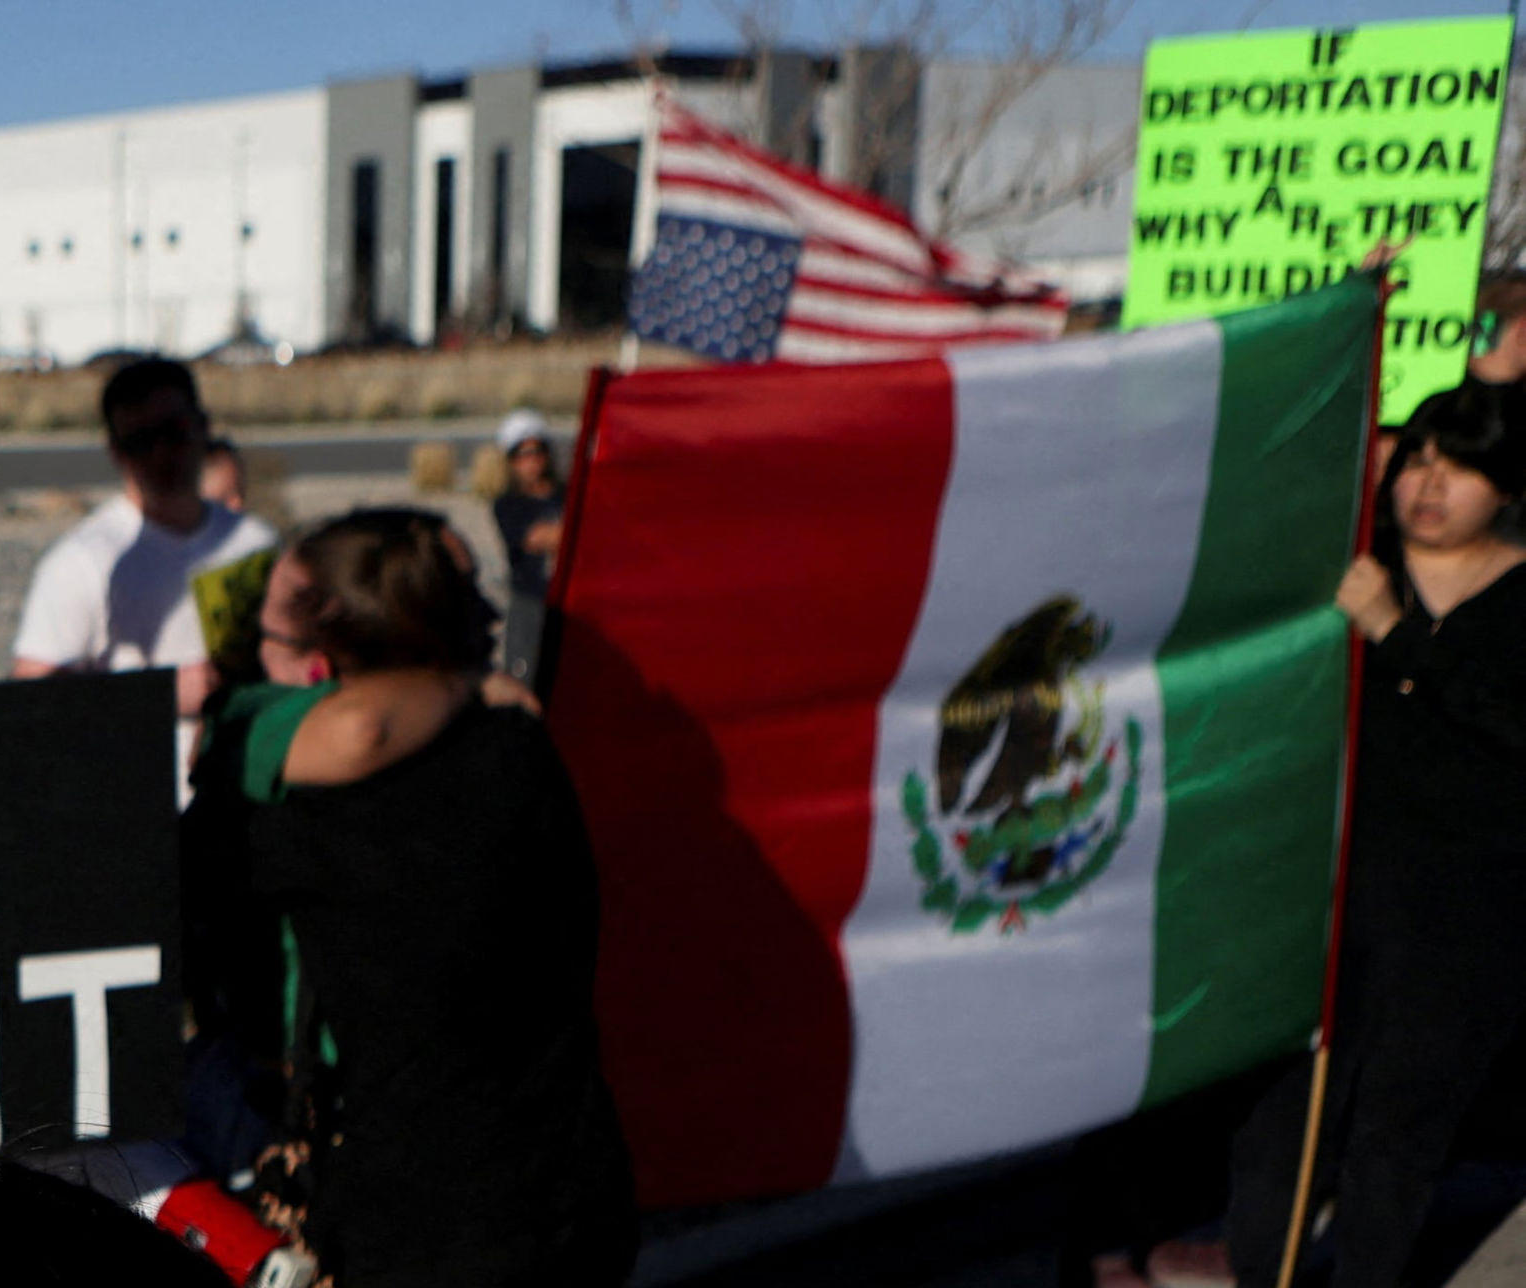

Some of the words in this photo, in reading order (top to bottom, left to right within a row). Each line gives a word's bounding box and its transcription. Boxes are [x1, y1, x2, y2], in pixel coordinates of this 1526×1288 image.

[1310, 29, 1356, 67] IF
[1145, 67, 1500, 123] DEPORTATION
[1152, 149, 1196, 184] IS
[1223, 140, 1314, 179] THE
[1336, 137, 1480, 176] GOAL
[1135, 209, 1242, 247] WHY
[1254, 178, 1349, 251] ARE
[1354, 199, 1485, 239] THEY
